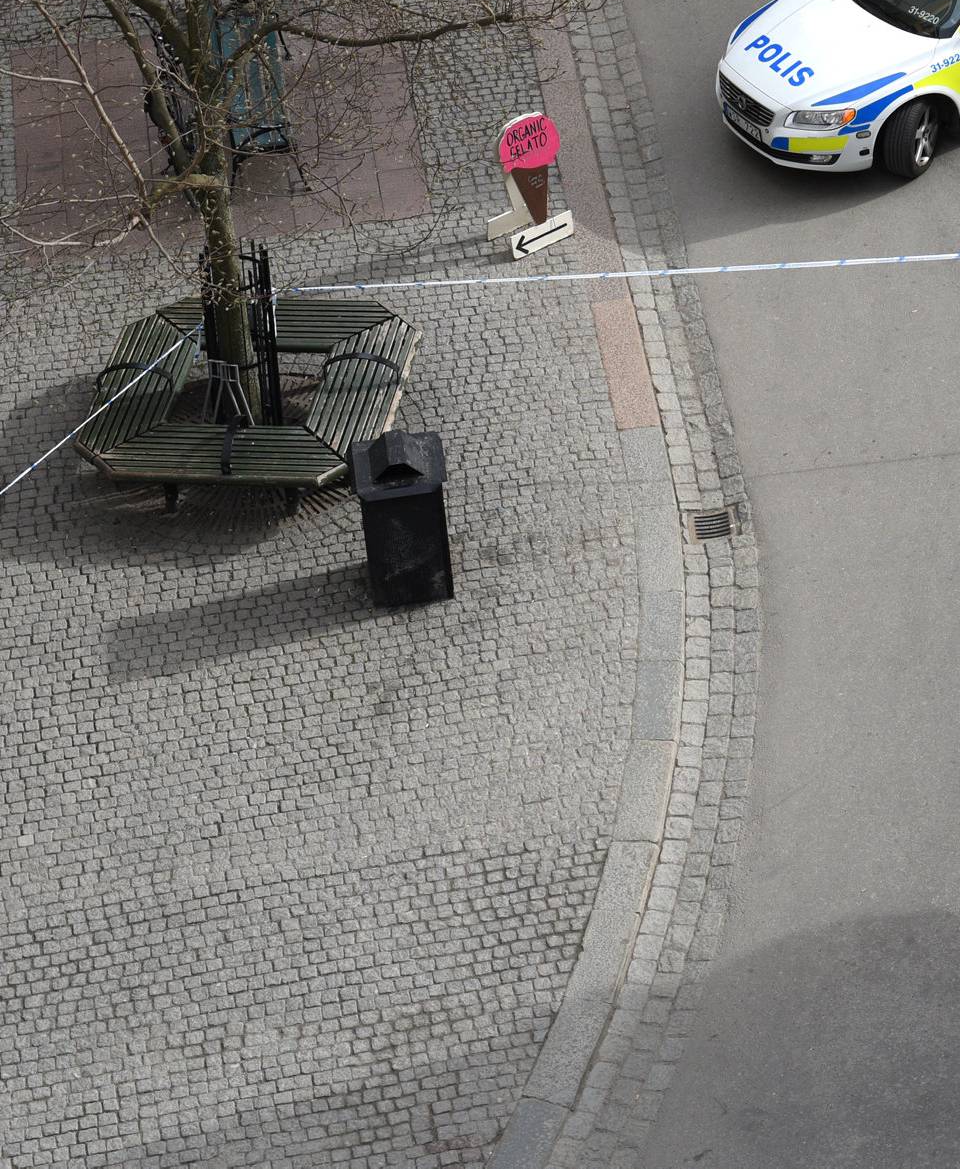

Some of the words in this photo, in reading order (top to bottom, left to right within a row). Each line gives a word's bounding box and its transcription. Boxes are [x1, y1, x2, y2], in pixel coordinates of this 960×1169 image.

[908, 5, 940, 25] 31-9220
[744, 34, 815, 87] POLIS
[506, 117, 548, 147] ORGANIC
[509, 132, 548, 159] GELATO
